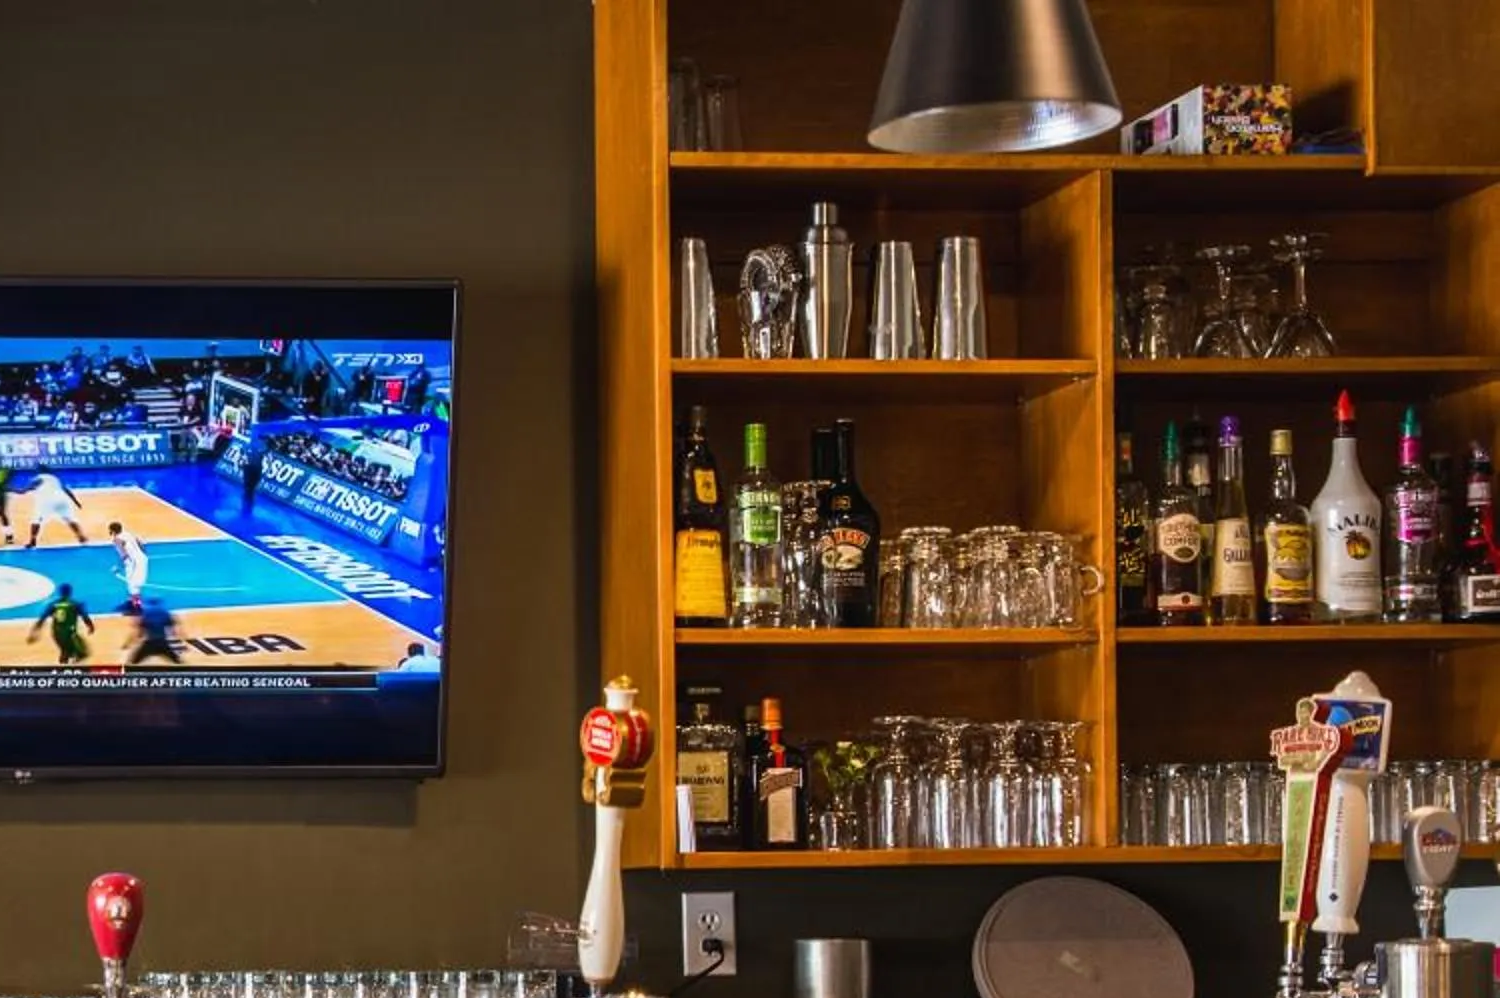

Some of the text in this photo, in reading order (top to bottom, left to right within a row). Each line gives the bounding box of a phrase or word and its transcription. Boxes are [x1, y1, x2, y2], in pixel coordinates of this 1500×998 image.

[40, 433, 163, 455] TISSOT
[326, 481, 399, 526] TISSOT
[167, 633, 307, 656] FIBA
[37, 677, 55, 689] OF
[57, 677, 79, 689] RIO
[81, 677, 148, 689] QUALIFIER
[150, 677, 192, 689] AFTER
[194, 677, 250, 689] BEATING
[252, 677, 311, 689] SENEGAL
